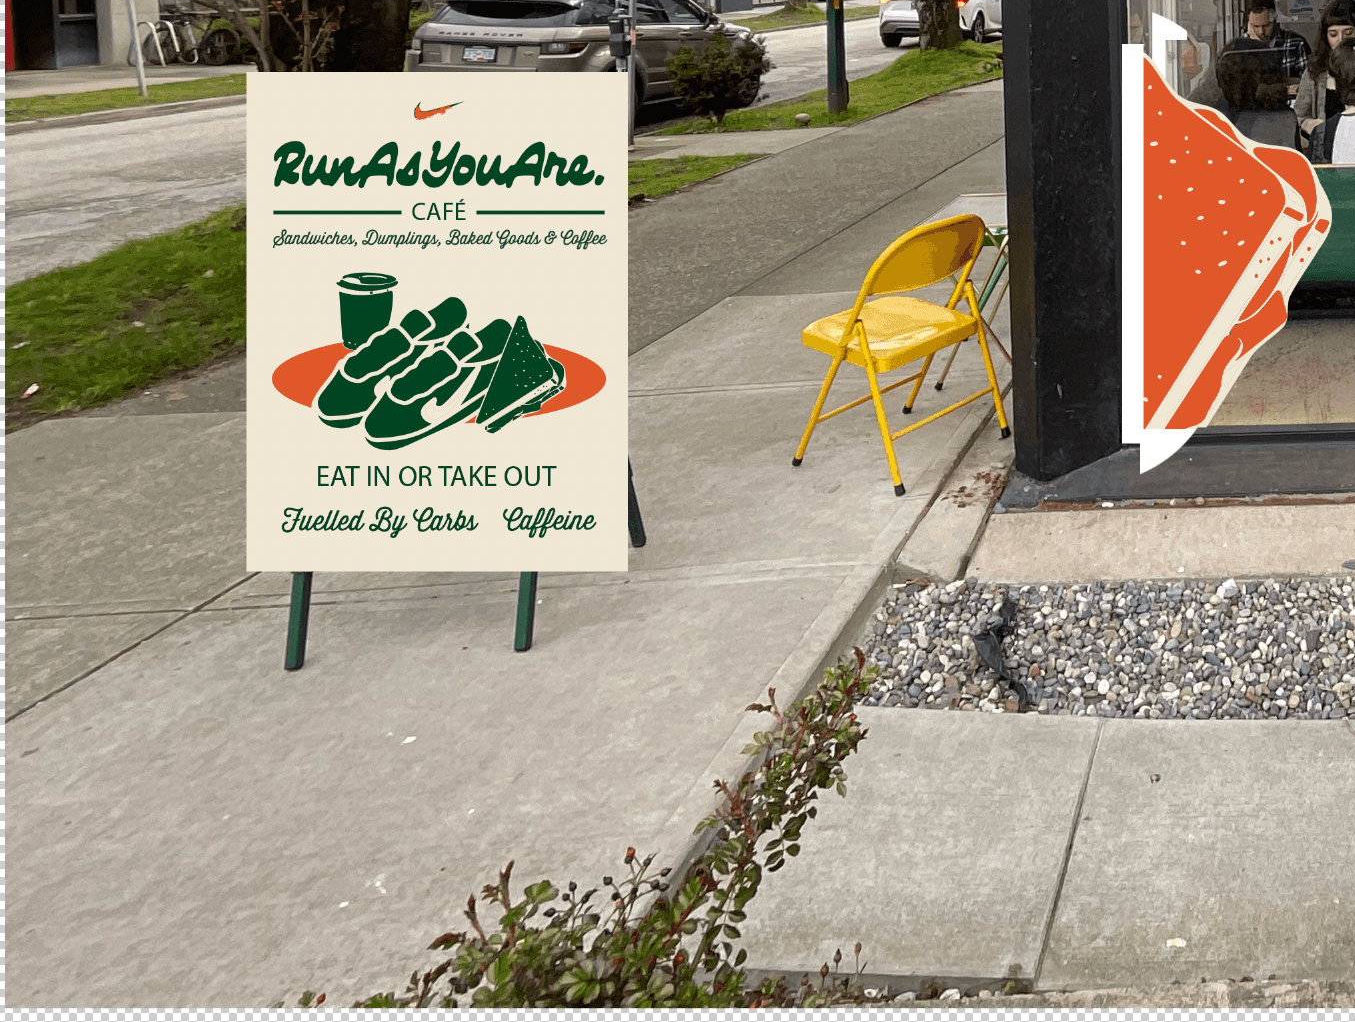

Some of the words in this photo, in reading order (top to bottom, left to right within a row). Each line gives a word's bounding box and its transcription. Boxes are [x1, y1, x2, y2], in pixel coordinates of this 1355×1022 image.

[273, 140, 605, 189] RunAsYouAre.
[411, 199, 467, 221] CAFÉ
[273, 229, 357, 249] Sandwiches,
[362, 229, 441, 249] Dumplings,
[446, 229, 493, 247] Baked
[495, 229, 541, 249] Goods
[544, 230, 557, 245] &
[560, 229, 608, 250] Coffee
[317, 465, 360, 487] EAT
[367, 465, 390, 487] IN
[398, 465, 432, 487] OR
[438, 465, 497, 487] TAKE
[503, 465, 558, 487] OUT
[281, 507, 365, 534] Fuelled
[369, 506, 409, 539] By
[412, 507, 479, 533] Carbs
[502, 507, 597, 539] Caffeine
